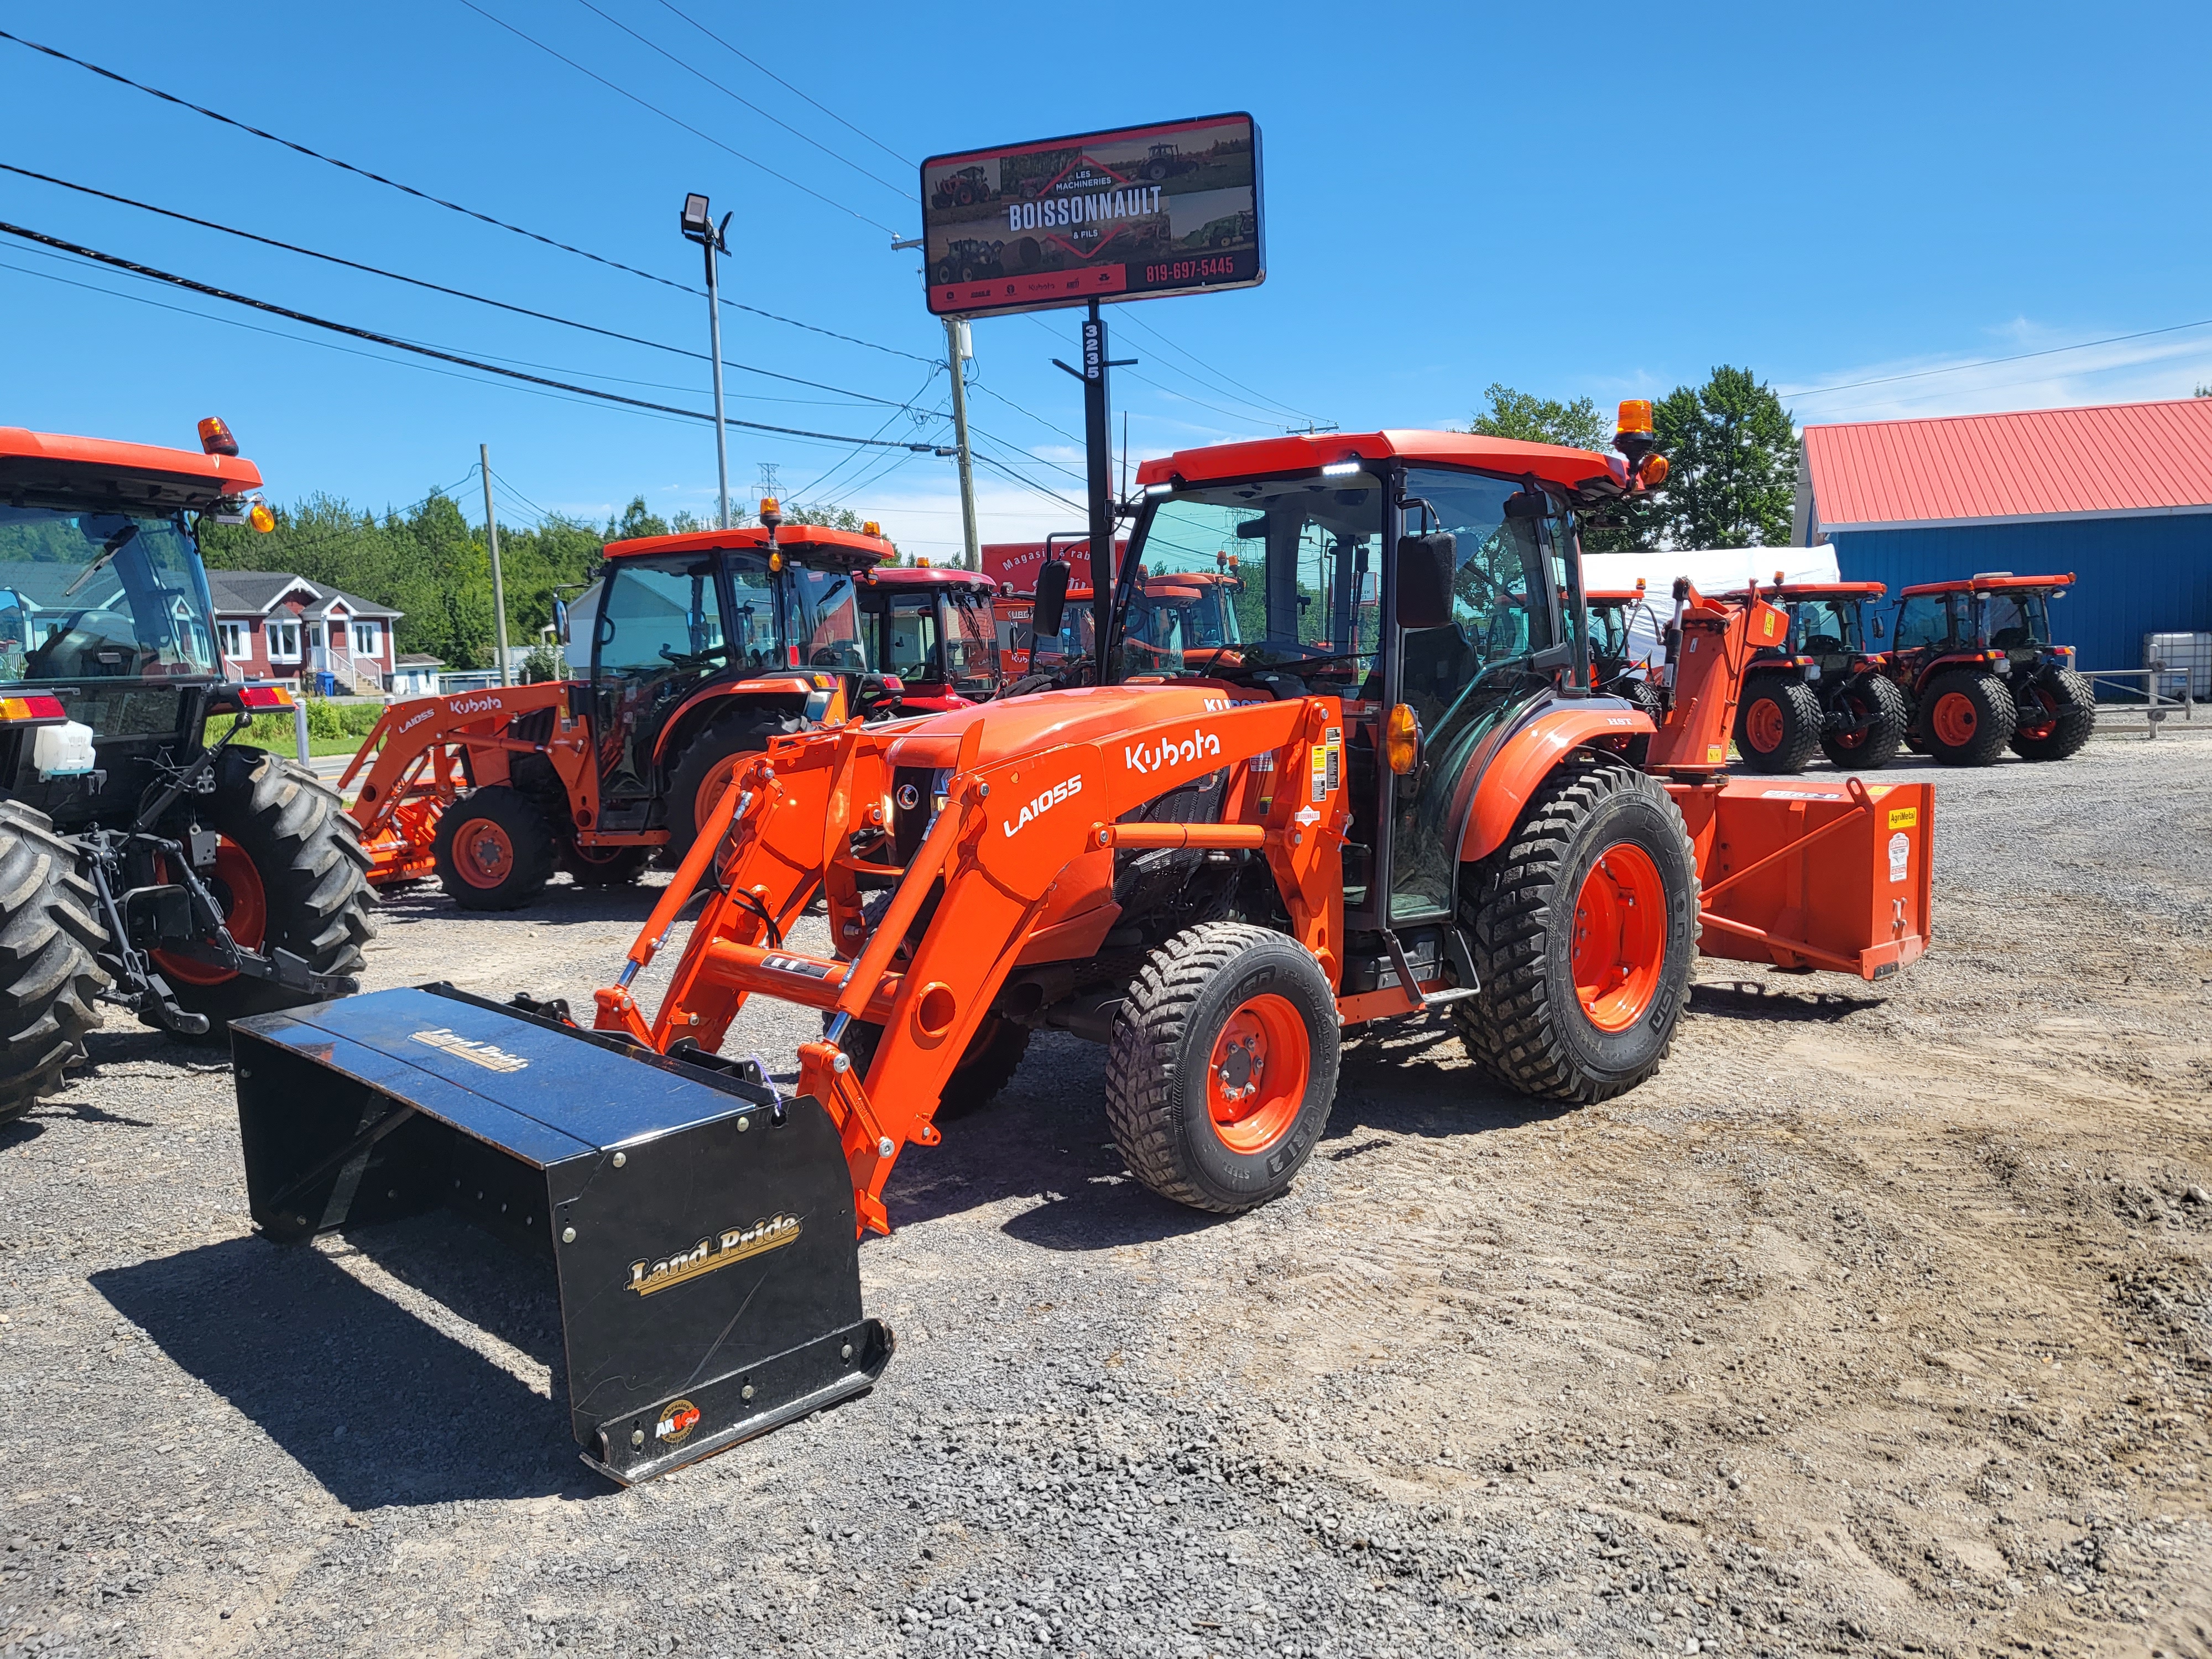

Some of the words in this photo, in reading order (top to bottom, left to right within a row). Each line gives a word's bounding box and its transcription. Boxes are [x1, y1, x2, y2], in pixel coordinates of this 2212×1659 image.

[1056, 176, 1112, 191] MACHINERIES
[1076, 170, 1091, 179] LES
[1009, 186, 1161, 232] BOISSONNAULT
[1081, 229, 1098, 238] FILS
[1146, 256, 1234, 283] 819-697-5445
[1029, 283, 1055, 291] Kubota
[1085, 324, 1099, 378] 3235
[1071, 550, 1091, 561] rab
[450, 696, 502, 714] Kubota
[398, 708, 435, 734] LA1055
[1124, 729, 1221, 774] Kubota
[1003, 774, 1082, 838] LA1055
[630, 1240, 709, 1290] Land
[719, 1214, 797, 1258] Pride
[655, 1408, 701, 1438] AR400
[664, 1402, 690, 1418] Abrasion
